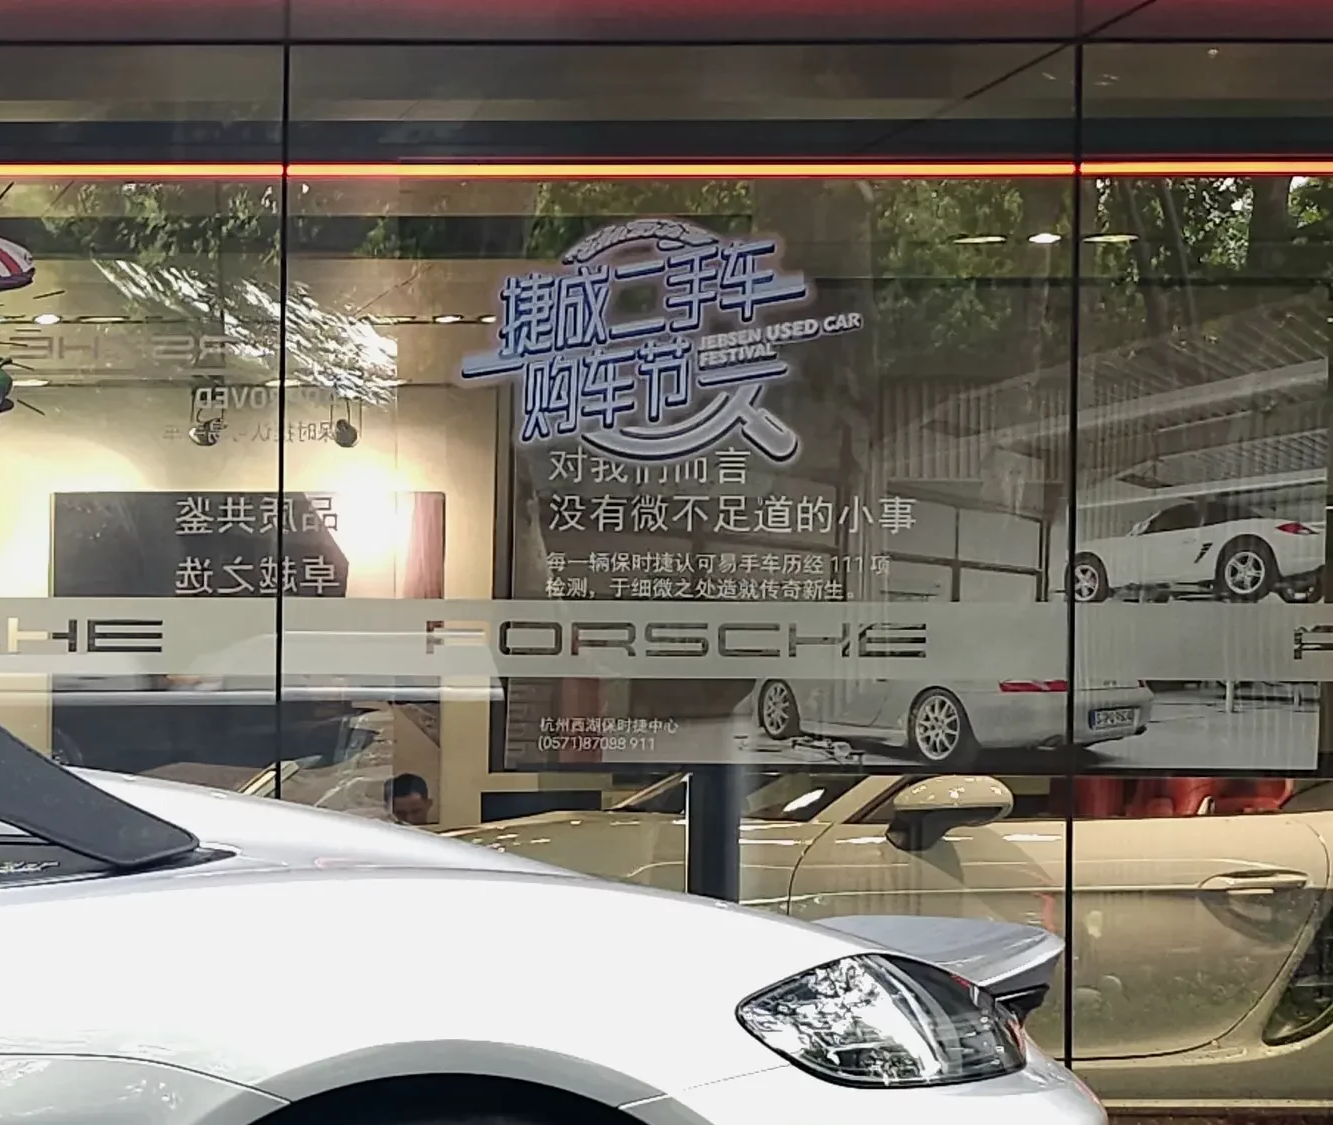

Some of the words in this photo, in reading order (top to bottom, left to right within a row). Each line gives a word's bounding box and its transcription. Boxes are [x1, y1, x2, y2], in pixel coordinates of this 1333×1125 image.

[500, 240, 806, 357] 捷成二手车
[699, 328, 762, 350] JEBSEN
[766, 319, 819, 341] USED
[823, 312, 861, 333] CAR
[699, 343, 777, 369] FESTIVAL
[522, 337, 692, 441] 购车节
[548, 493, 917, 534] 没有微不足道的小事
[426, 620, 927, 658] PORSCHE
[539, 717, 679, 734] 杭州西湖保时捷中心
[629, 737, 655, 750] 911
